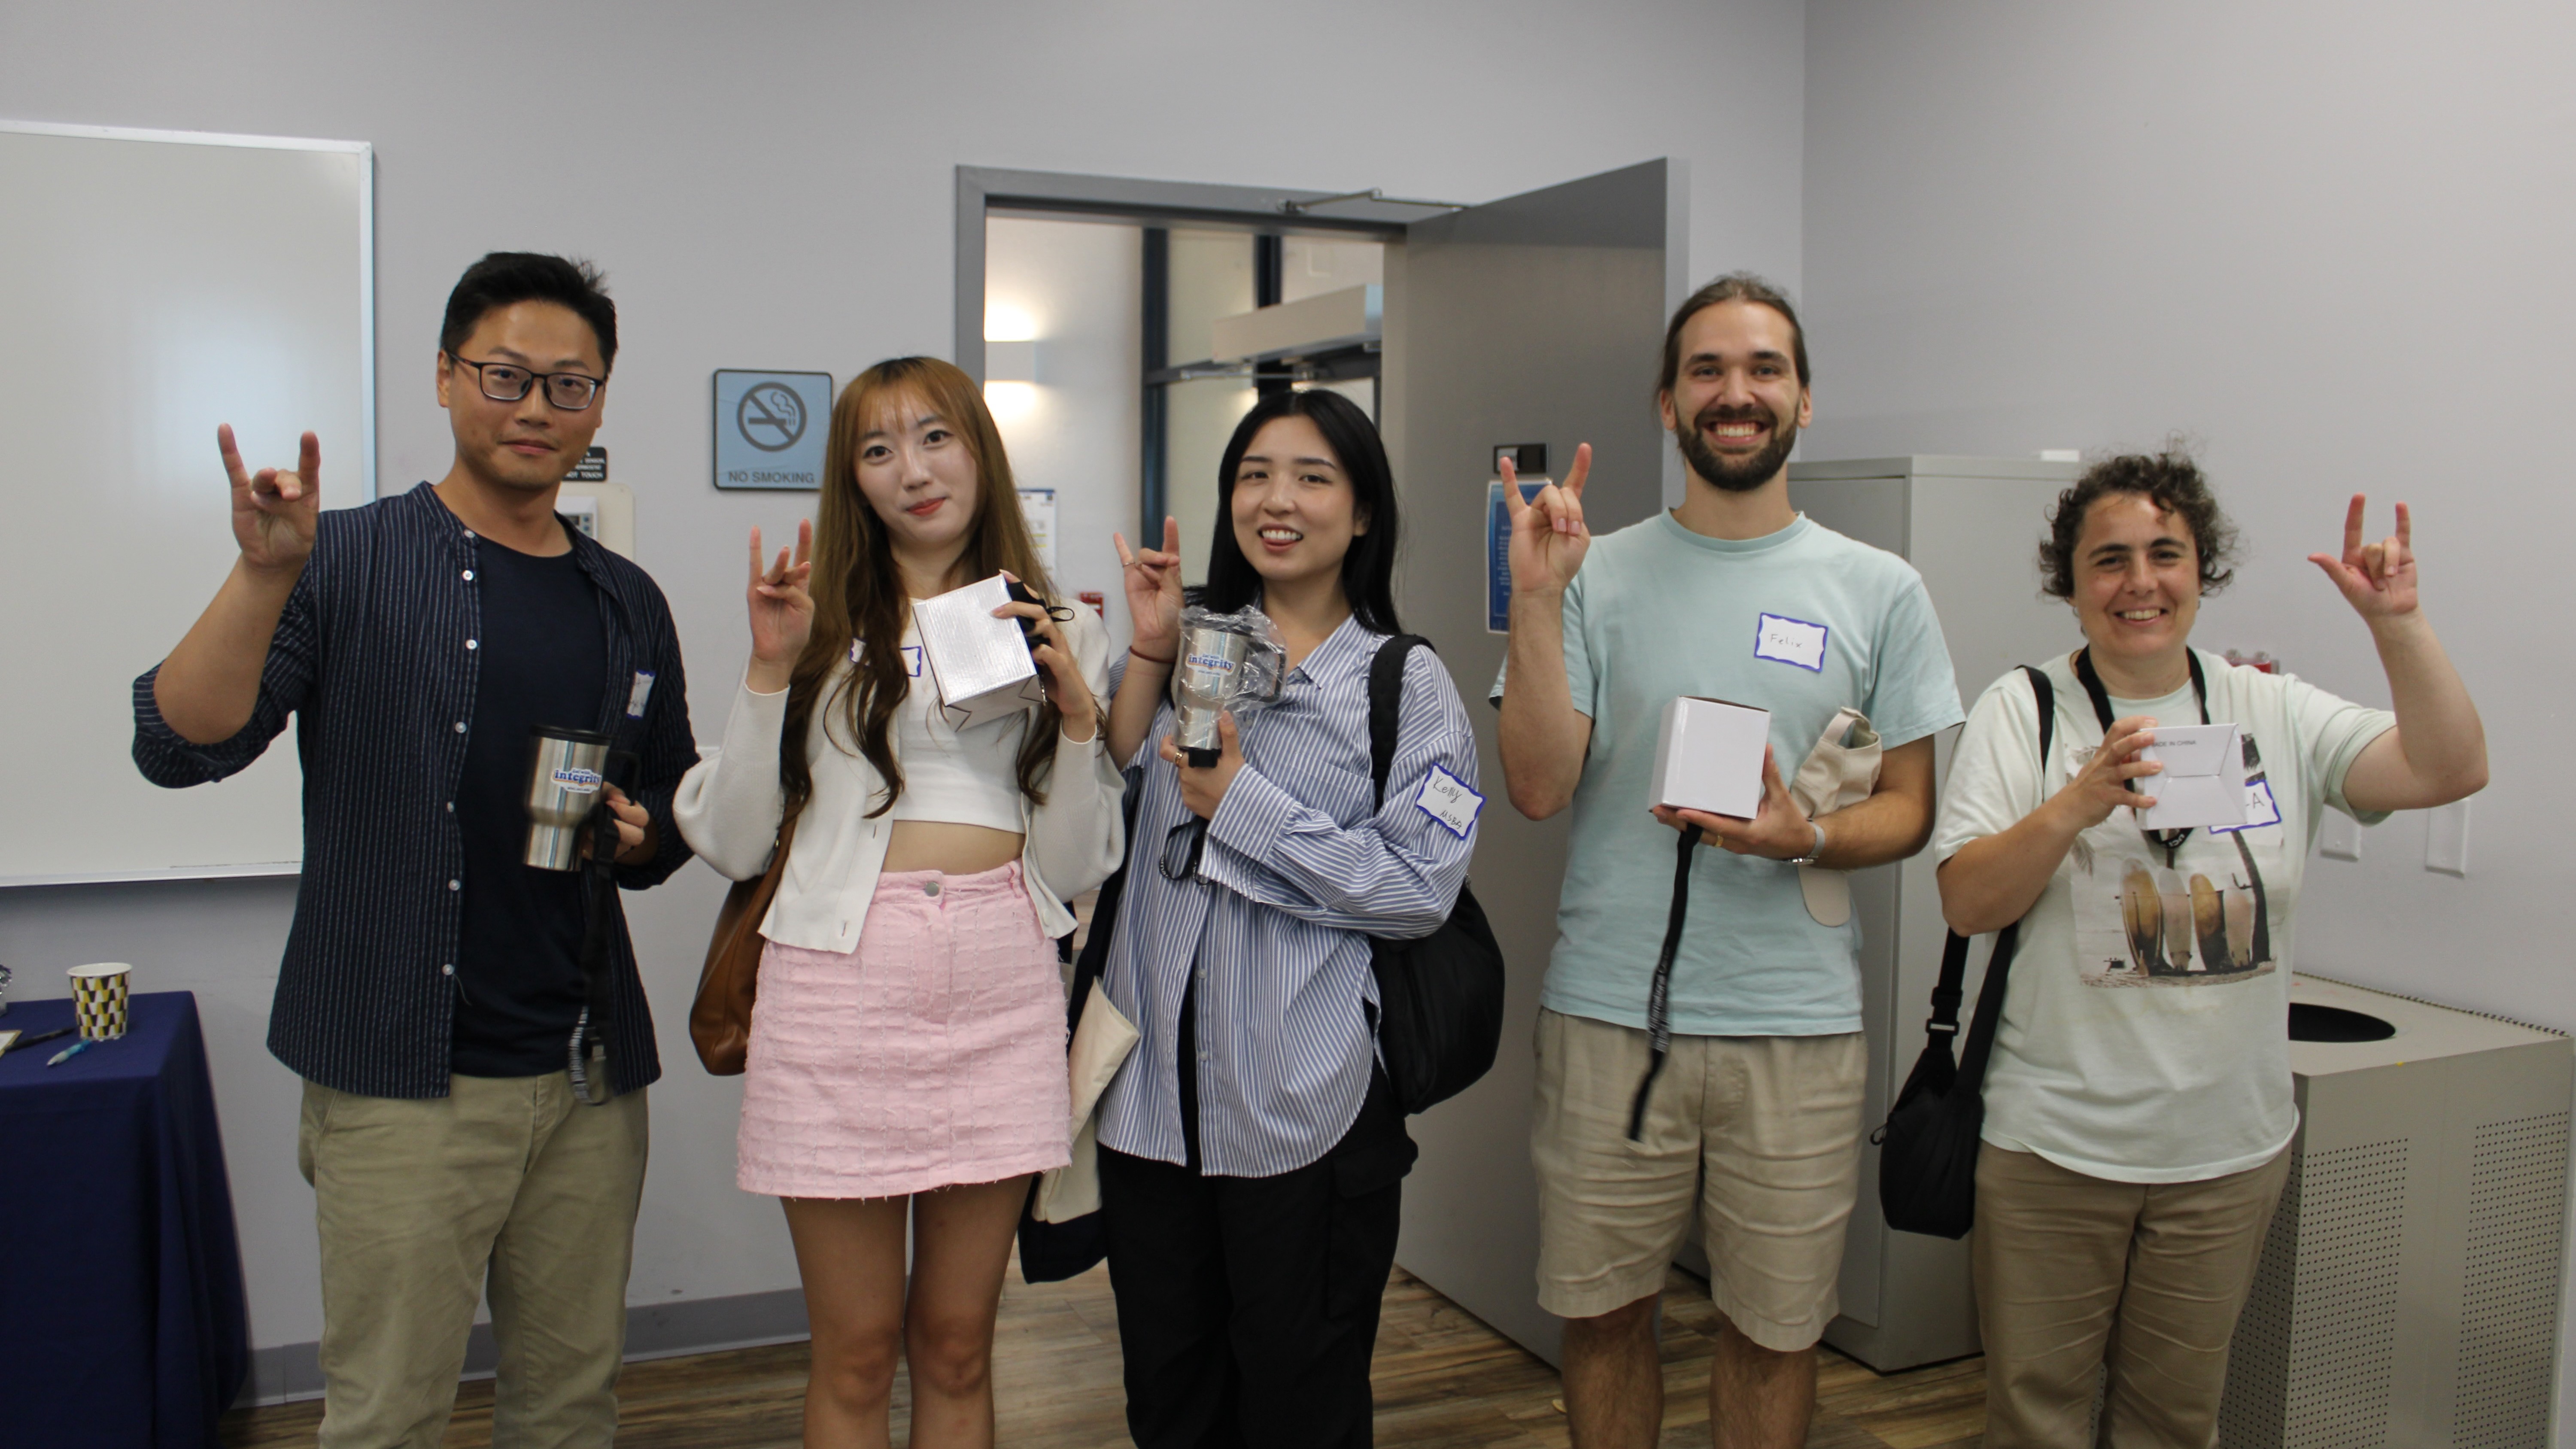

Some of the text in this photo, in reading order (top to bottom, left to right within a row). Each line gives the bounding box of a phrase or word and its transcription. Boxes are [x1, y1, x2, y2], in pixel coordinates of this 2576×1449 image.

[729, 471, 814, 483] NO SMOKING
[1770, 633, 1803, 648] Felix
[1188, 654, 1233, 671] integrity
[1433, 776, 1463, 804] Kelly
[1440, 810, 1463, 829] MSBA
